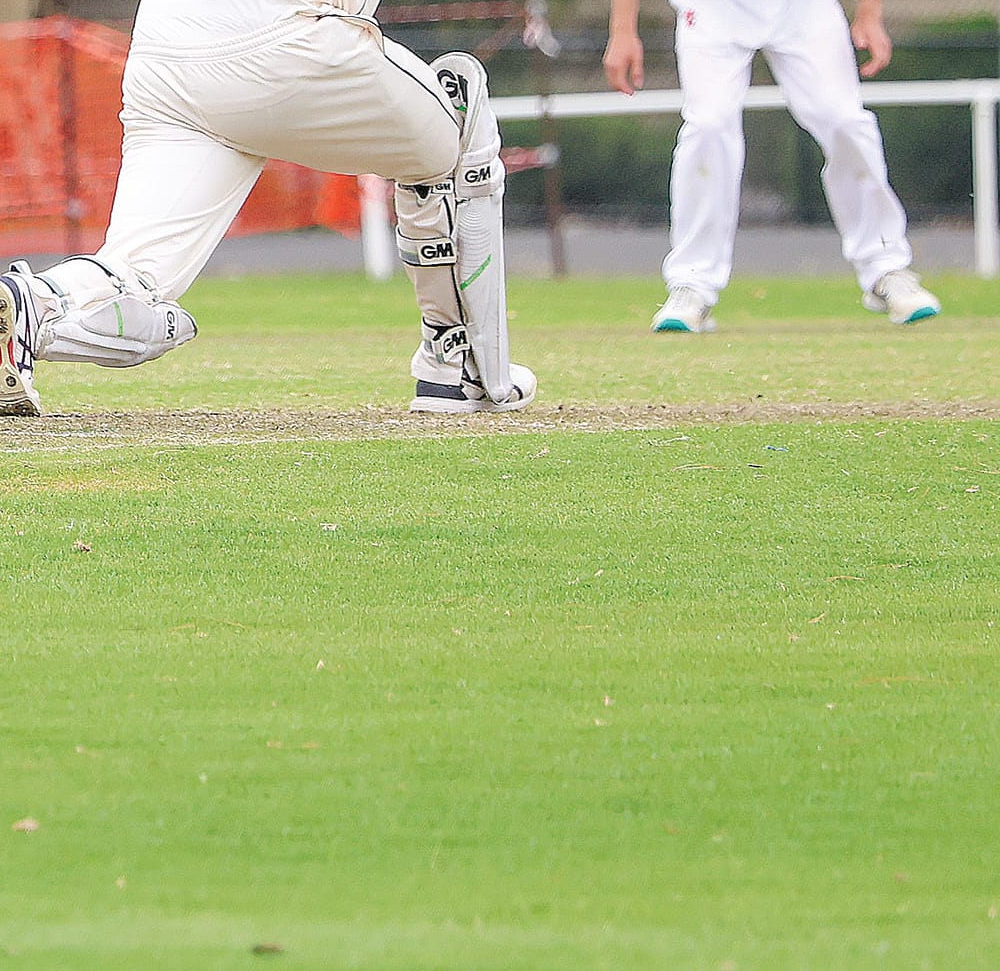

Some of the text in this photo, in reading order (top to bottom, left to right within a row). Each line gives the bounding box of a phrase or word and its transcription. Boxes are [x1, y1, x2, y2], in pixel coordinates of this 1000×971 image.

[464, 166, 492, 183] GM
[421, 242, 455, 259] GM
[167, 311, 175, 340] GM
[443, 330, 468, 354] GM
